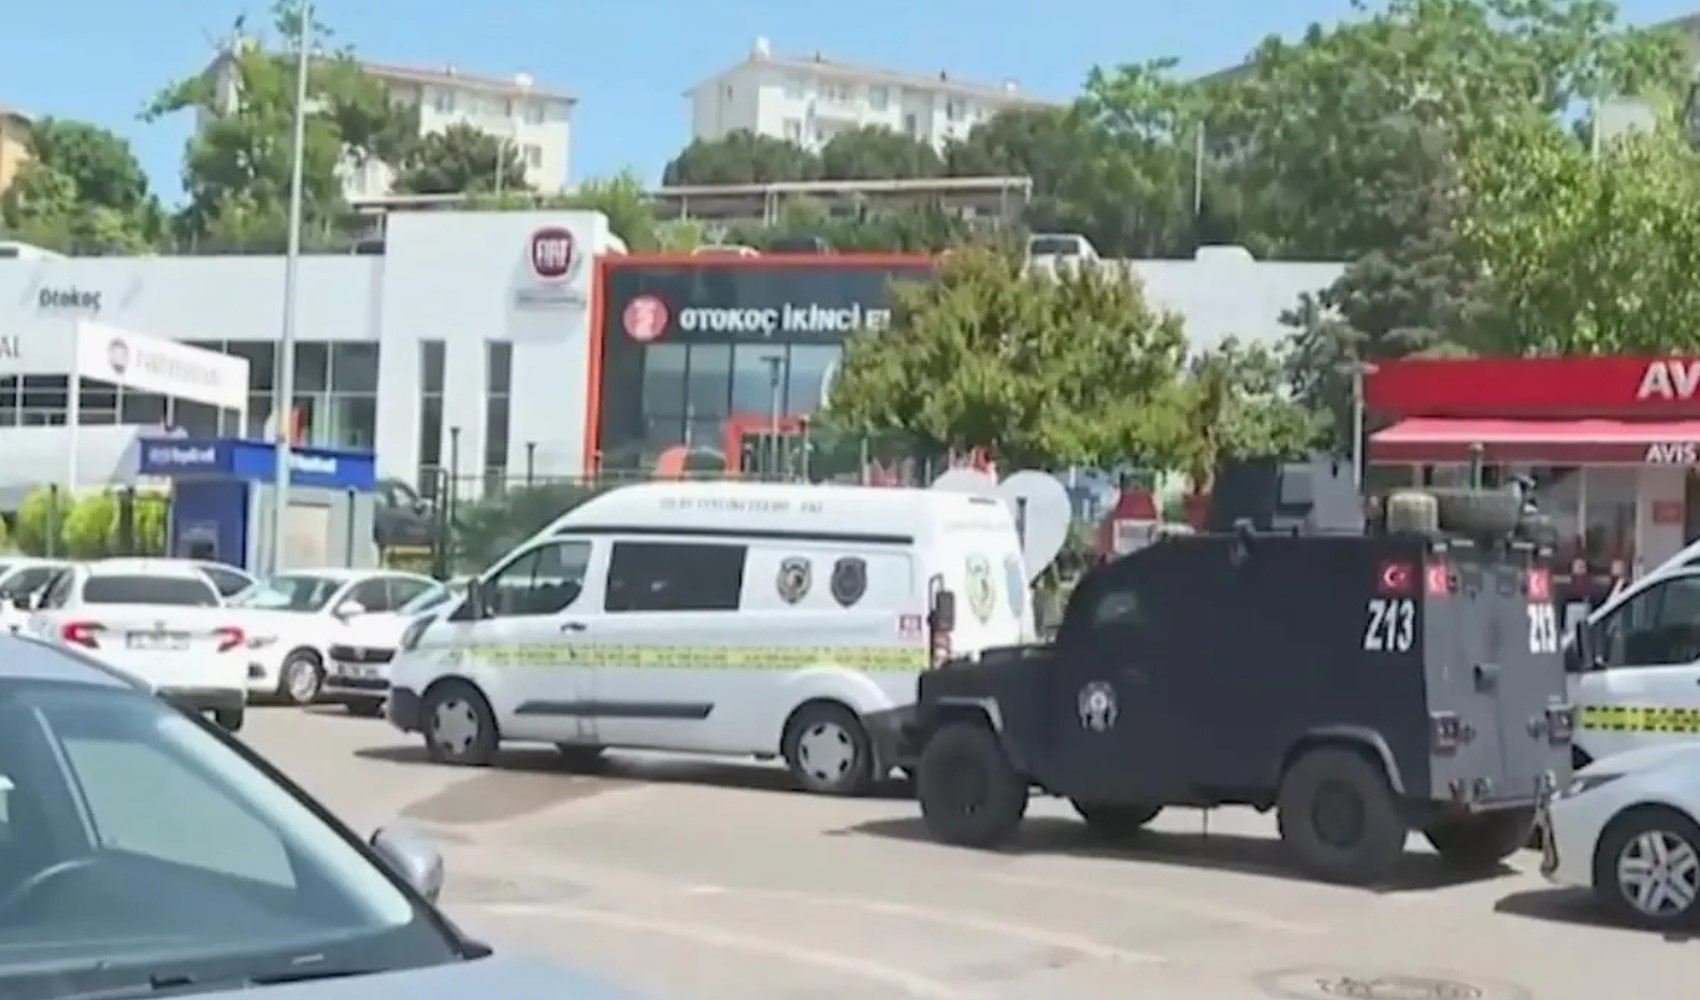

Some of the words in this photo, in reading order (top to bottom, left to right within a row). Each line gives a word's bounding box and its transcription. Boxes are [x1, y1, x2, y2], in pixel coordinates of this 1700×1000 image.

[535, 238, 570, 268] FIAT
[680, 307, 778, 337] OTOKOÇ
[783, 302, 861, 331] İKİNCİ
[1637, 360, 1700, 399] AV
[1646, 443, 1698, 464] AVIS
[1364, 599, 1415, 652] Z13
[1527, 603, 1557, 654] Z13
